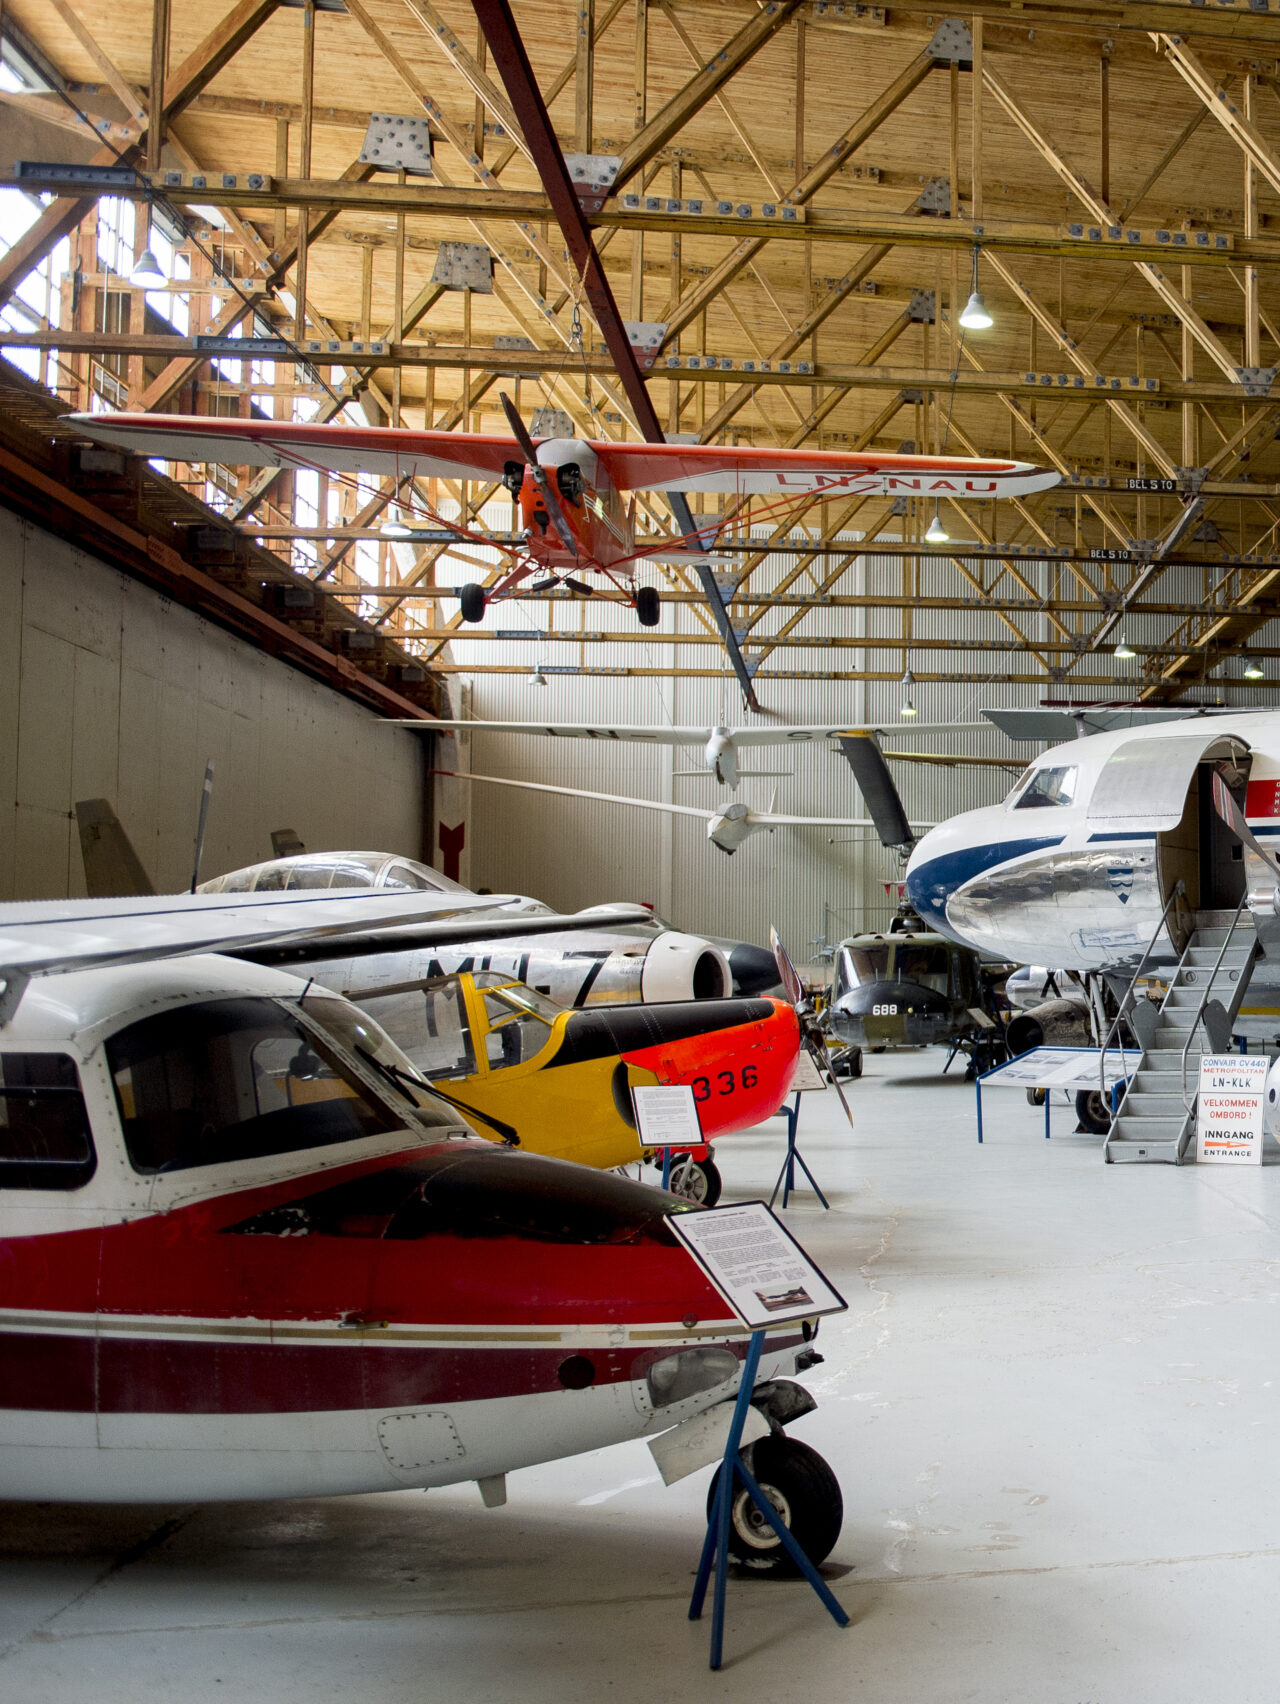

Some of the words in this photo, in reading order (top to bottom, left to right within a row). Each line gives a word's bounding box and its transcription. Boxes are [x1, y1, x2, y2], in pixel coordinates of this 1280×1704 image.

[776, 474, 997, 492] LN-NAU
[1129, 479, 1148, 489] BEL
[1090, 549, 1107, 559] BEL
[872, 1004, 898, 1016] 688
[1203, 1058, 1236, 1067] CONVAIR
[1203, 1067, 1265, 1075] METROPOLITAN
[692, 1064, 758, 1102] 336
[1212, 1077, 1252, 1088] LN-KLK
[1203, 1099, 1258, 1108] VELKOMMEN
[1204, 1130, 1254, 1140] INNGANG
[1203, 1149, 1252, 1157] ENTRANCE
